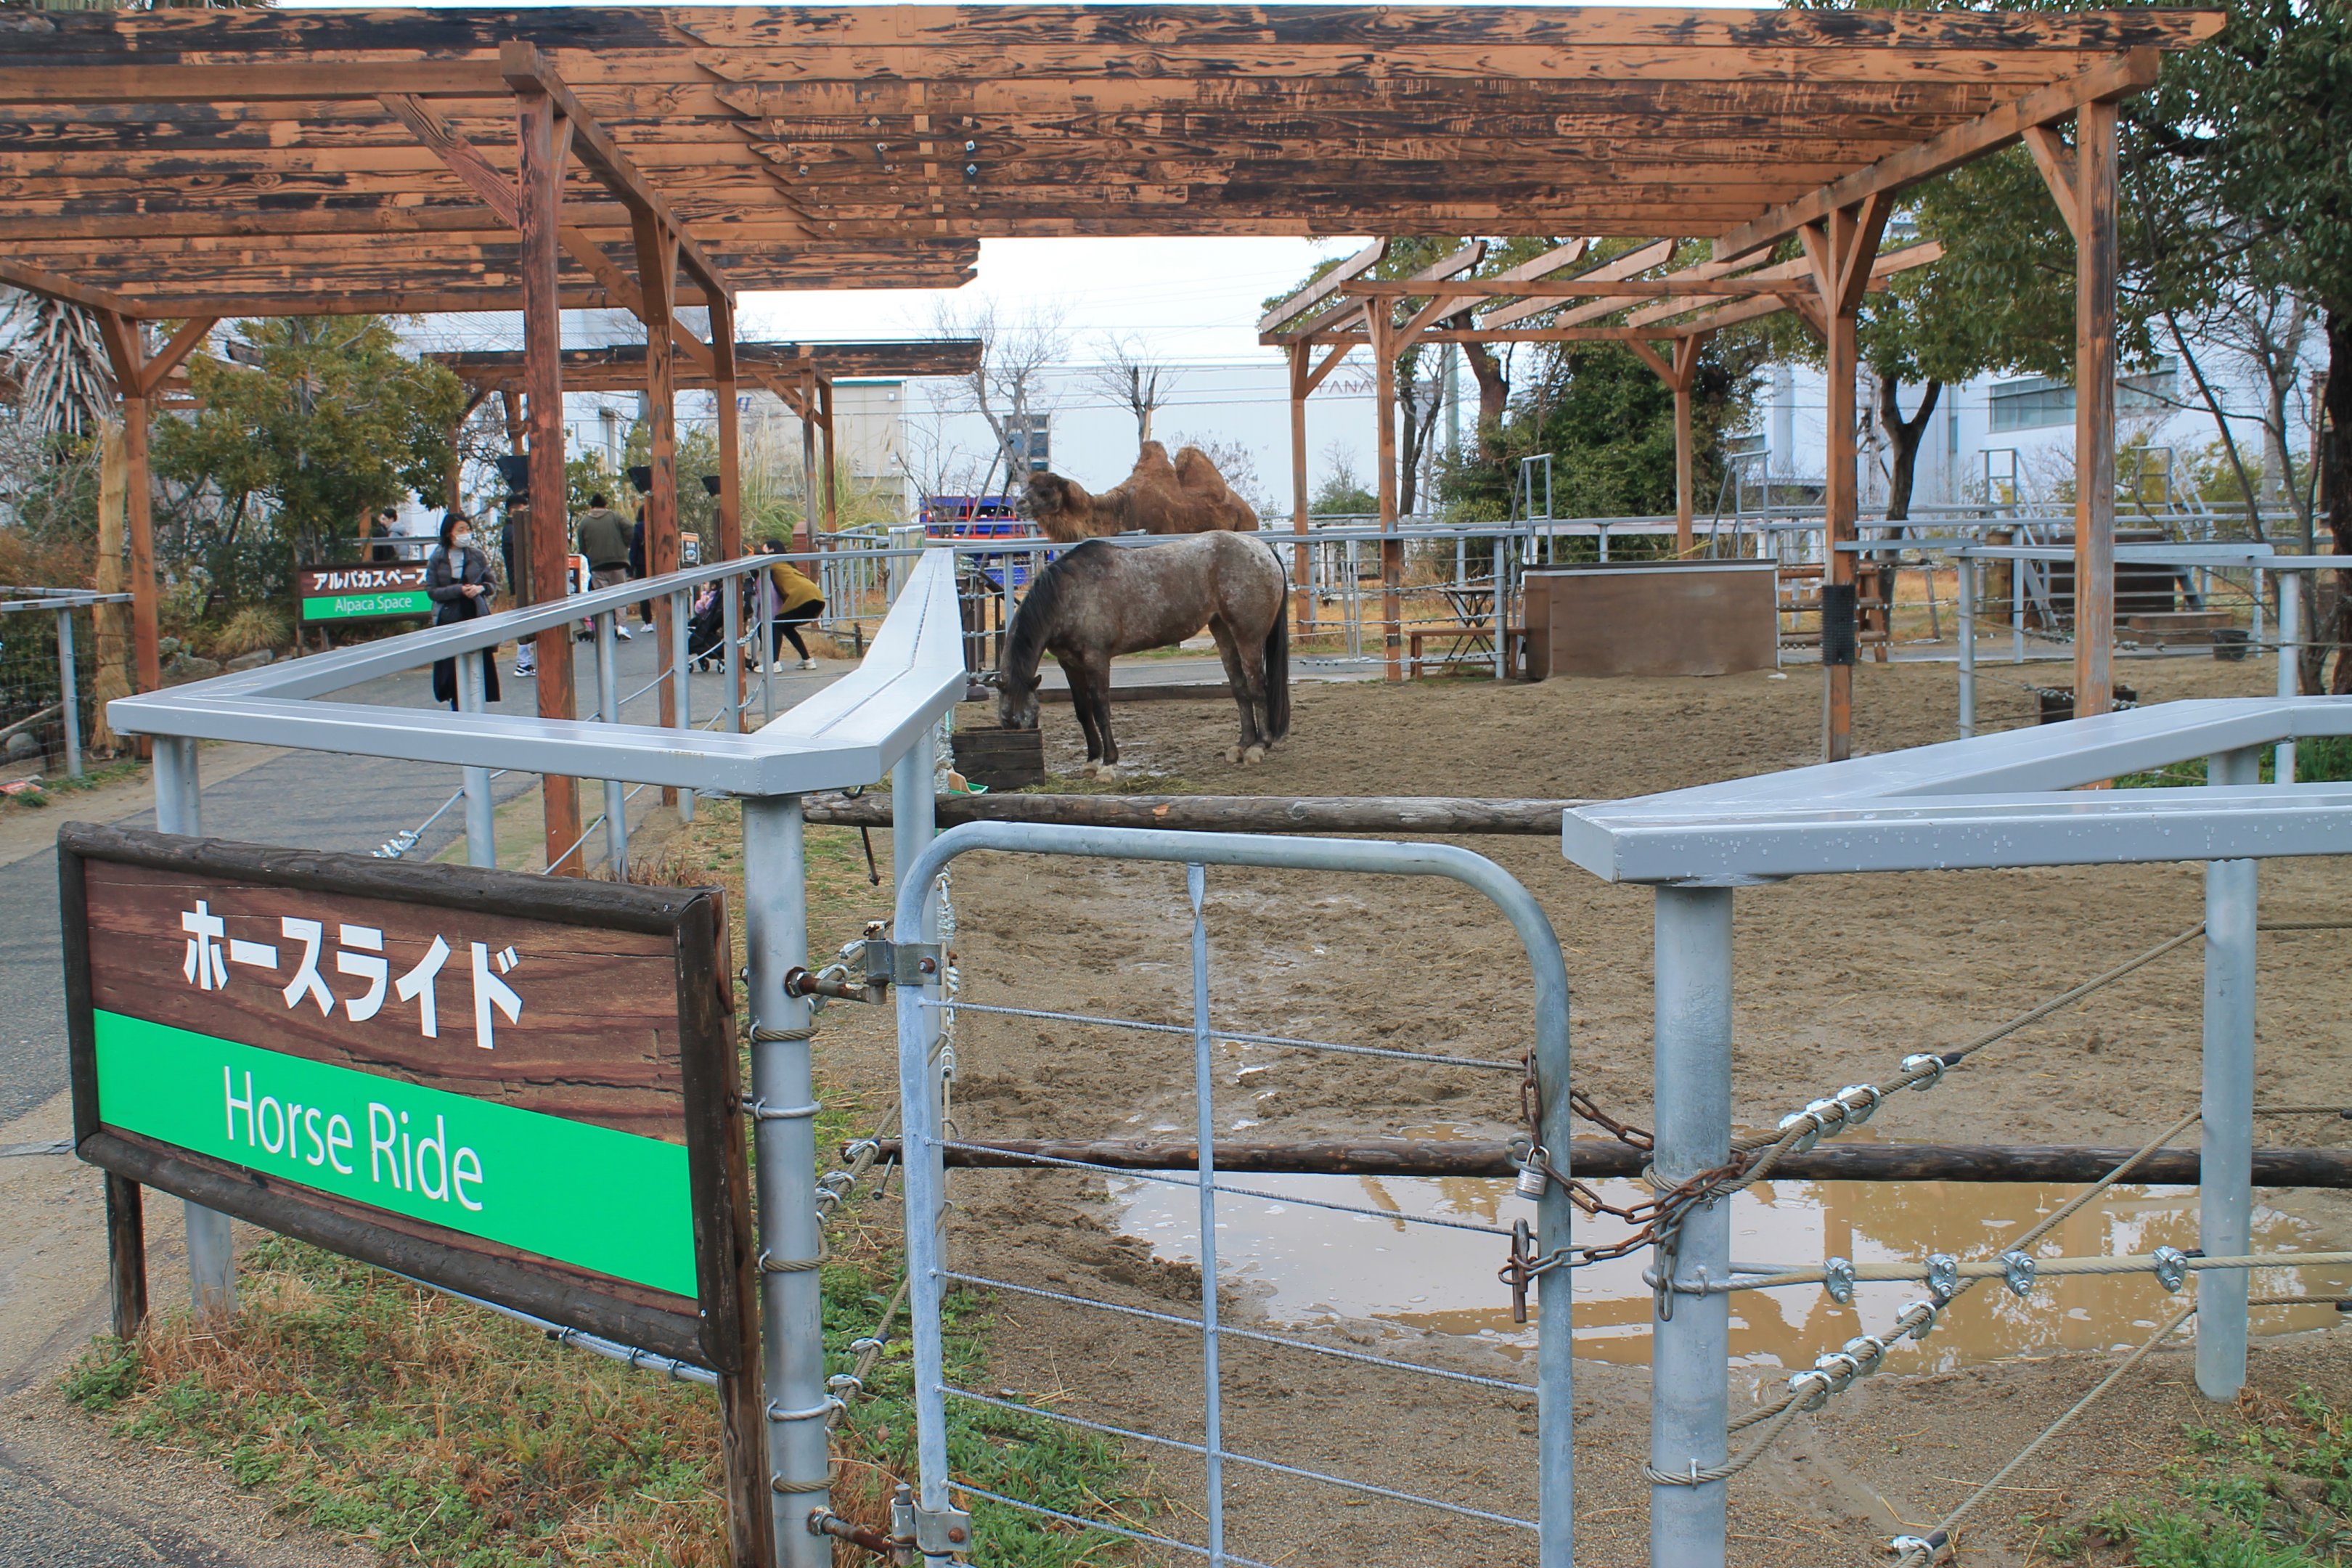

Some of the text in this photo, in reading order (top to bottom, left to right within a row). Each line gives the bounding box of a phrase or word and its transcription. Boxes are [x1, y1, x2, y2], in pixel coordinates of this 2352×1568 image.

[313, 568, 428, 591] アルパカスペース
[335, 595, 412, 615] Alpaca Space
[181, 899, 523, 1050] ホースライド
[224, 1066, 483, 1211] Horse Ride
